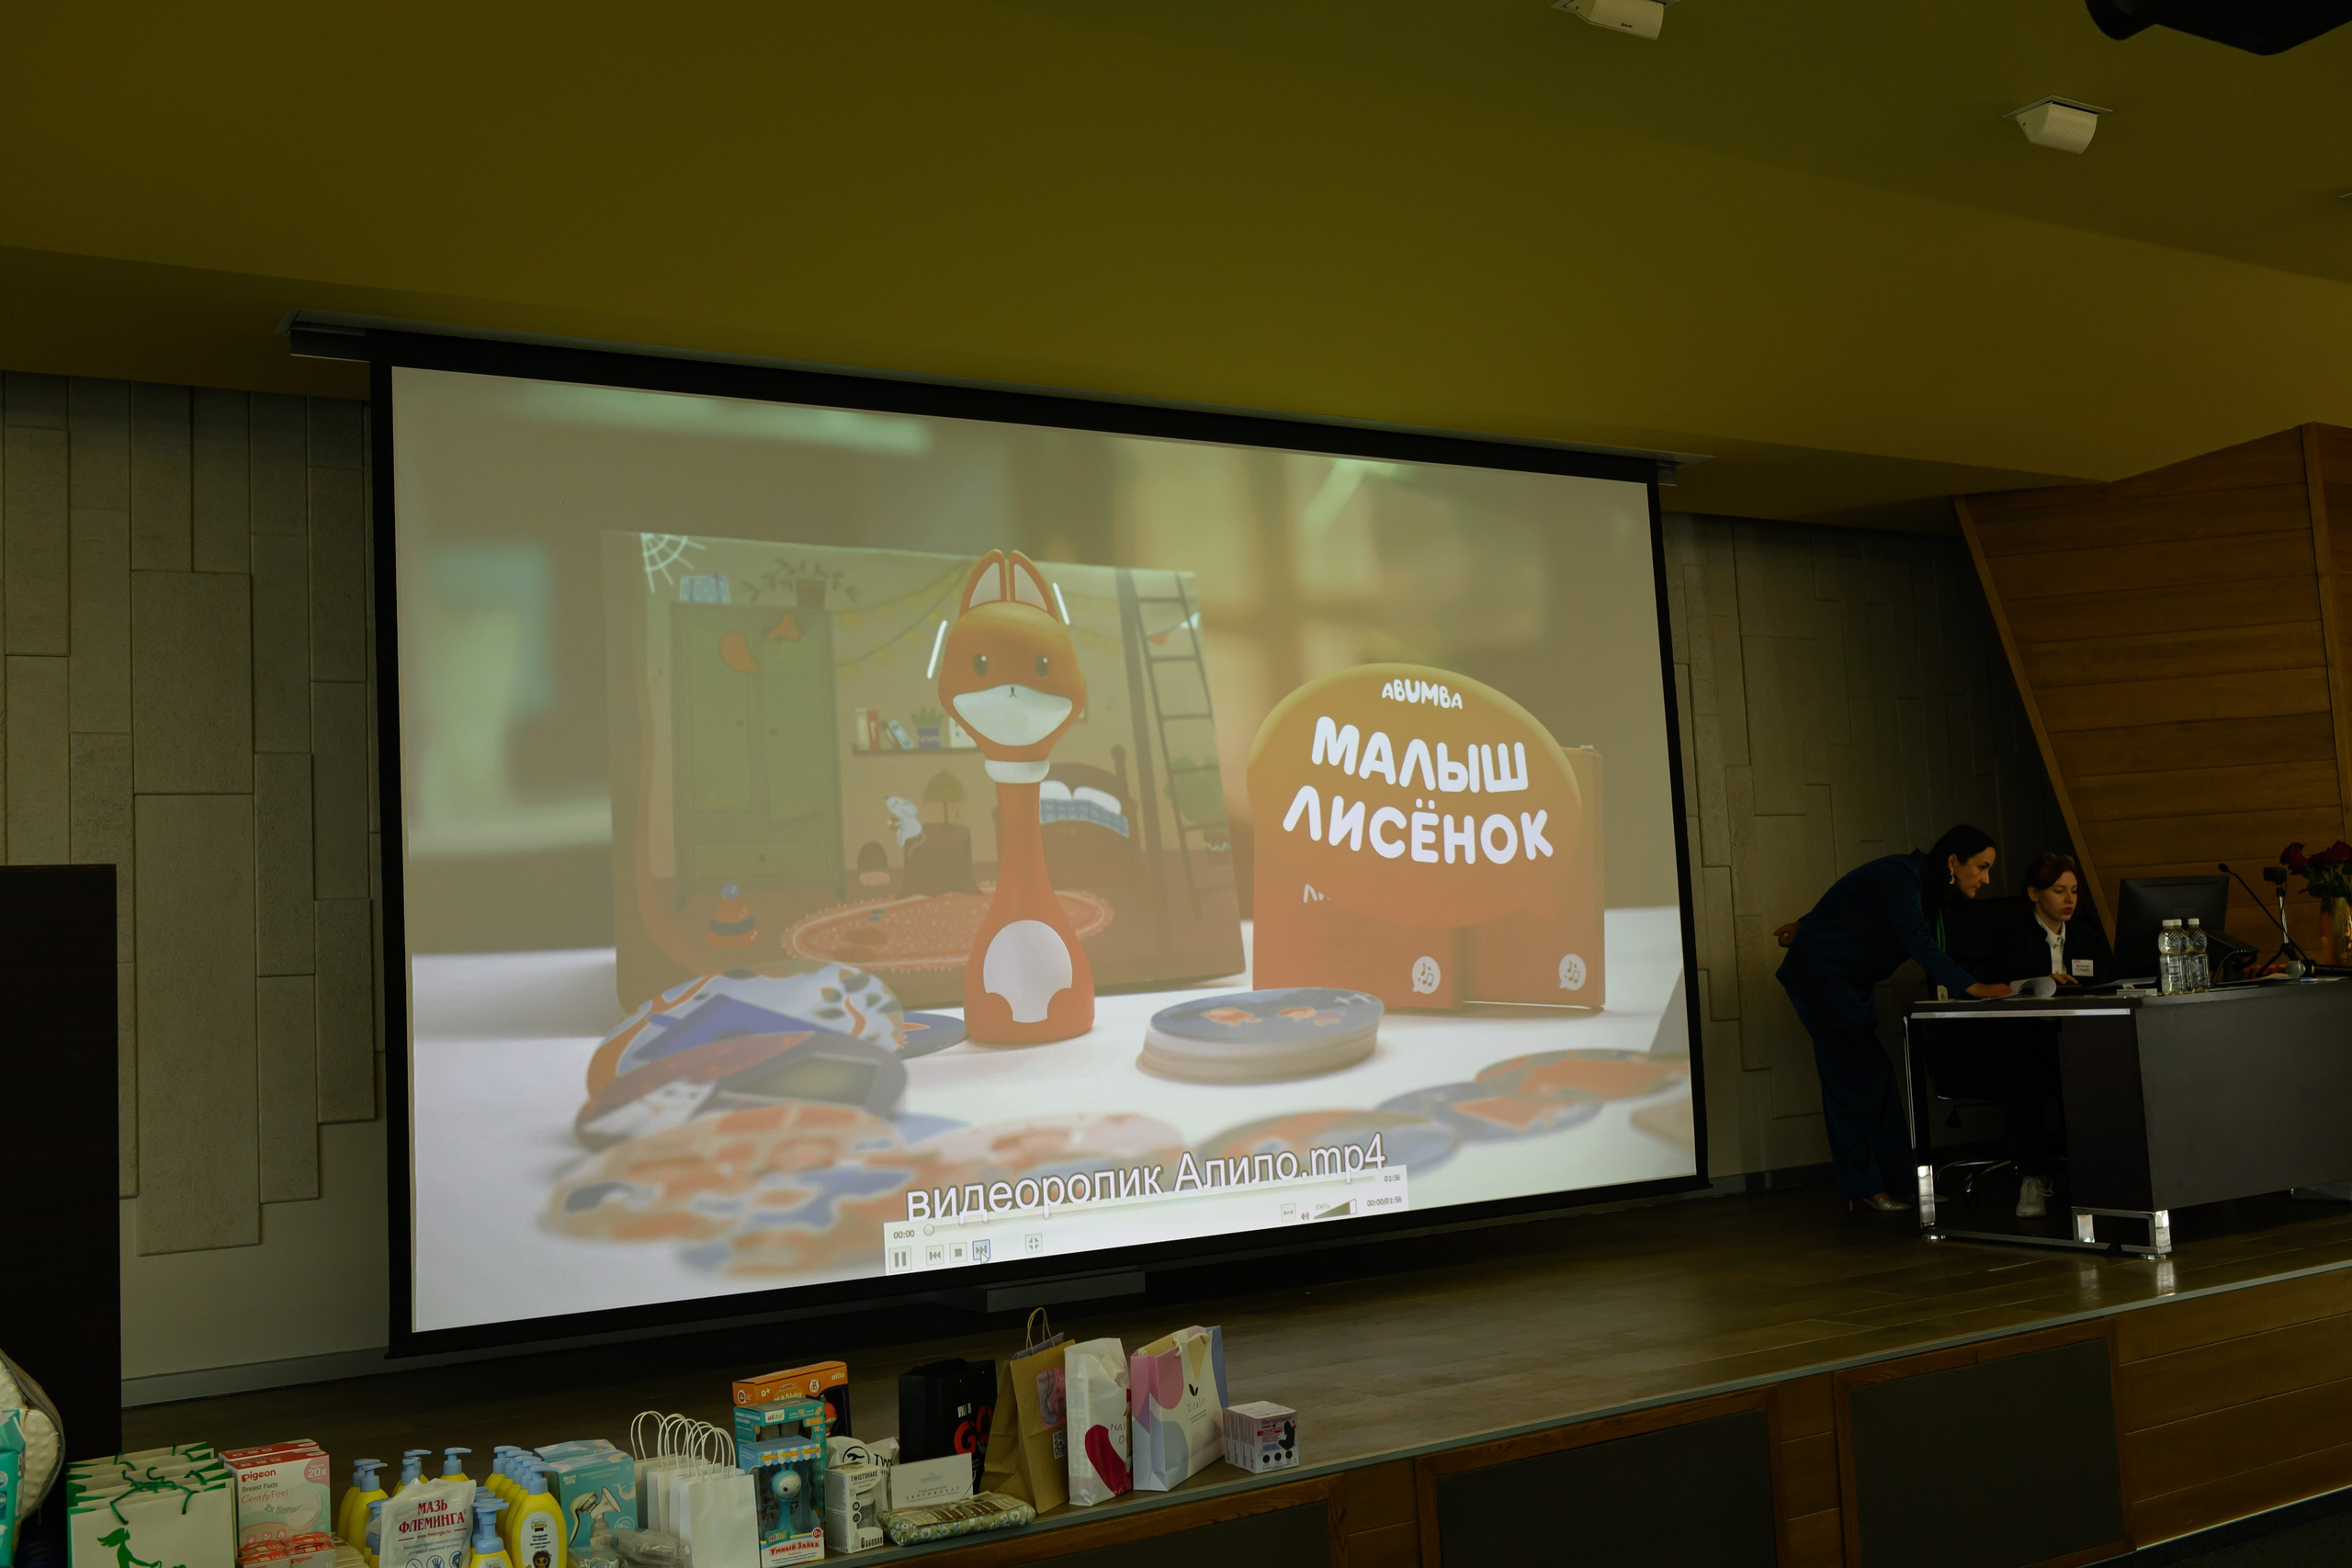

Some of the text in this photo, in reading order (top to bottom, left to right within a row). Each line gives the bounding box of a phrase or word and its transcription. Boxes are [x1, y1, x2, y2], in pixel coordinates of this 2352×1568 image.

[1381, 678, 1463, 709] ABUMBA
[1311, 716, 1529, 794] МАЛЫШ
[1283, 784, 1554, 864] ЛИСЁНОК
[906, 1132, 1386, 1225] видеоролик Алило.mp4
[1384, 1174, 1401, 1182] 01:56
[1366, 1196, 1402, 1207] 00:00/01:56
[893, 1230, 915, 1239] 00:00
[831, 1372, 845, 1381] alilo
[761, 1388, 771, 1397] 0+
[242, 1470, 277, 1483] pigeon
[308, 1468, 327, 1478] 20x
[851, 1471, 878, 1482] TWISTSHAKE
[417, 1499, 448, 1515] МАЗЬ
